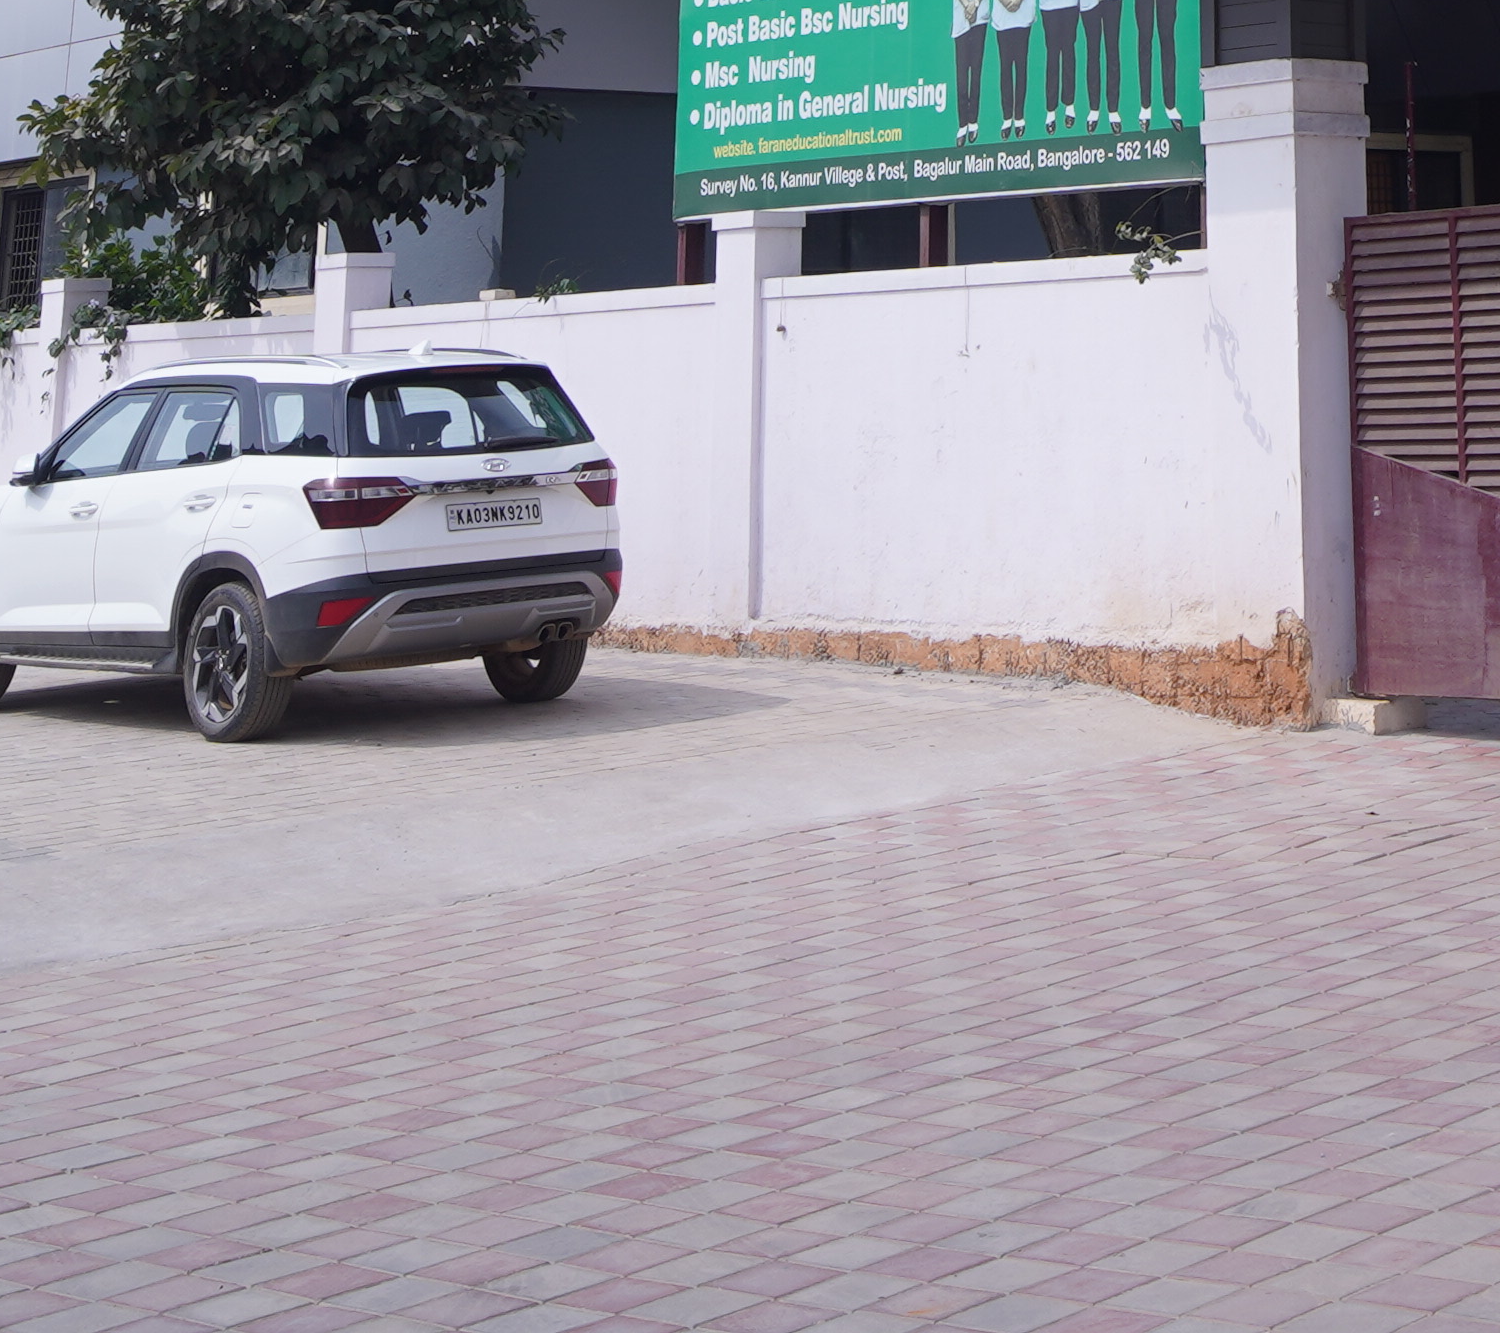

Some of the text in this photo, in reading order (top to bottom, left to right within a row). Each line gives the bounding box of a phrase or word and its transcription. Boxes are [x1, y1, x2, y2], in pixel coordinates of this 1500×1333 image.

[706, 21, 743, 48] Post
[748, 12, 796, 43] Basic
[801, 8, 833, 36] Bsc
[705, 51, 815, 90] Msc Nursing
[703, 80, 947, 135] Diploma in General Nursing
[758, 127, 902, 155] faraneducationaltrust.com
[700, 176, 737, 197] Survey
[739, 174, 757, 193] No.
[760, 172, 778, 192] 16,
[780, 168, 821, 189] Kannur
[824, 165, 863, 185] Villege
[866, 166, 874, 181] &
[878, 162, 907, 183] Post,
[913, 156, 962, 181] Bagalur
[964, 152, 995, 173] Main
[998, 150, 1034, 172] Road,
[1037, 146, 1105, 169] Bangalore
[1116, 141, 1141, 160] 562
[1144, 140, 1170, 160] 149
[456, 504, 540, 526] KA03NK9210
